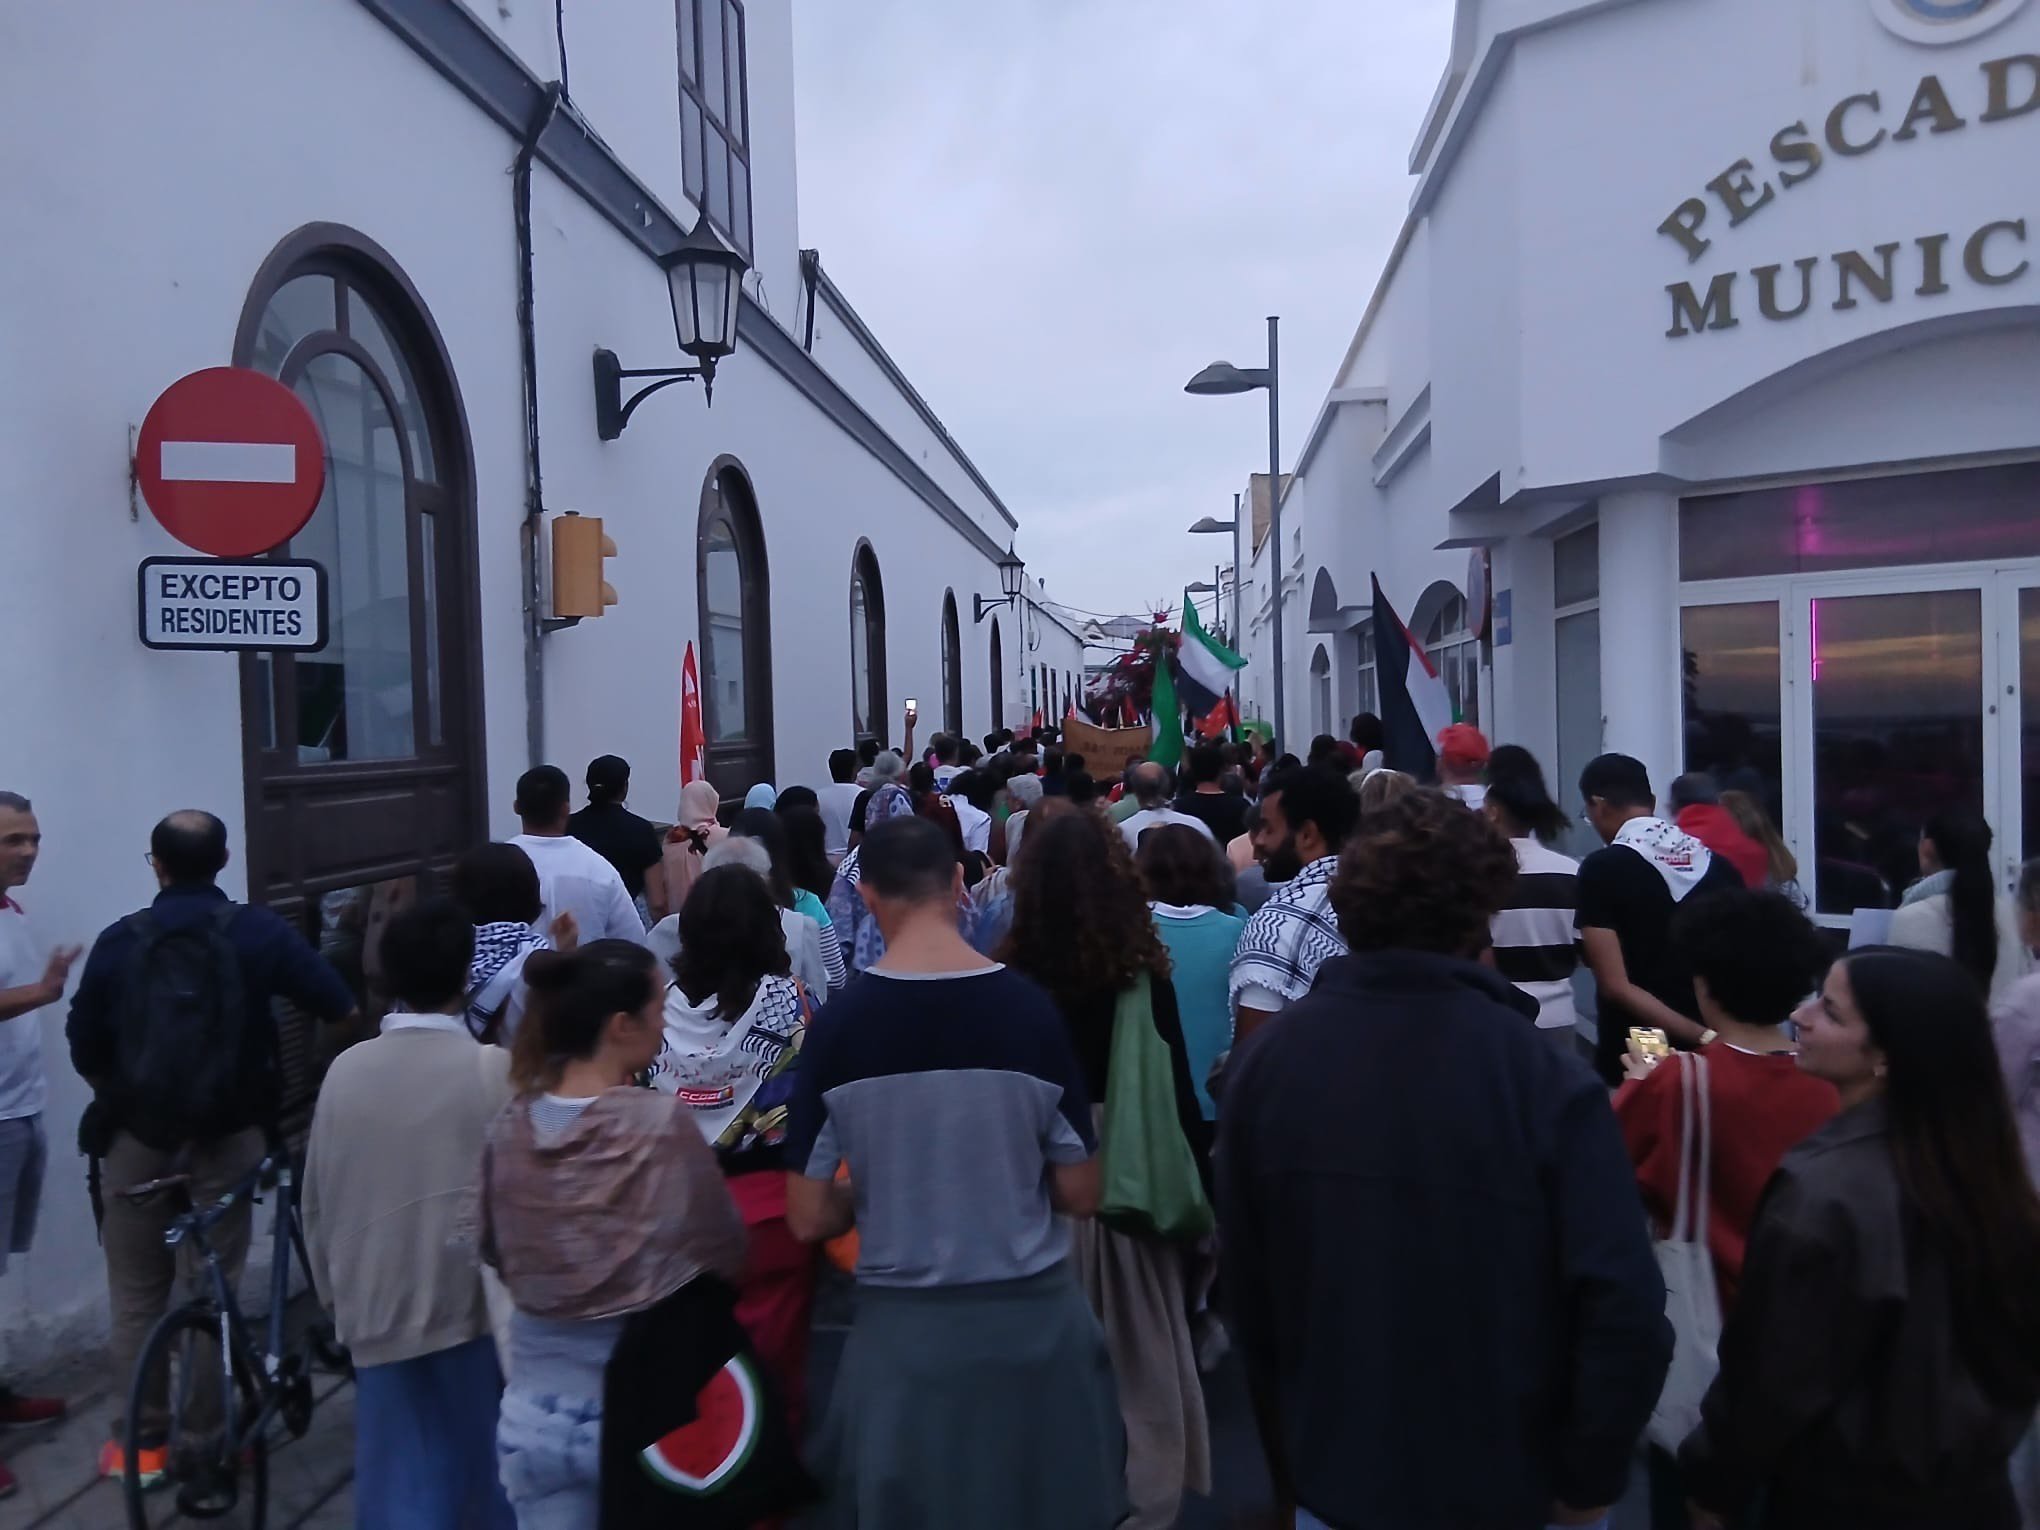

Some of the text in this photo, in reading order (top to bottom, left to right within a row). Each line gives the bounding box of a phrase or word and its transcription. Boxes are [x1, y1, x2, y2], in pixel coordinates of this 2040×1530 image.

[1657, 53, 2040, 264] PESCAD
[1665, 218, 2030, 339] MUNIC
[160, 573, 301, 602] EXCEPTO
[161, 607, 301, 636] RESIDENTES
